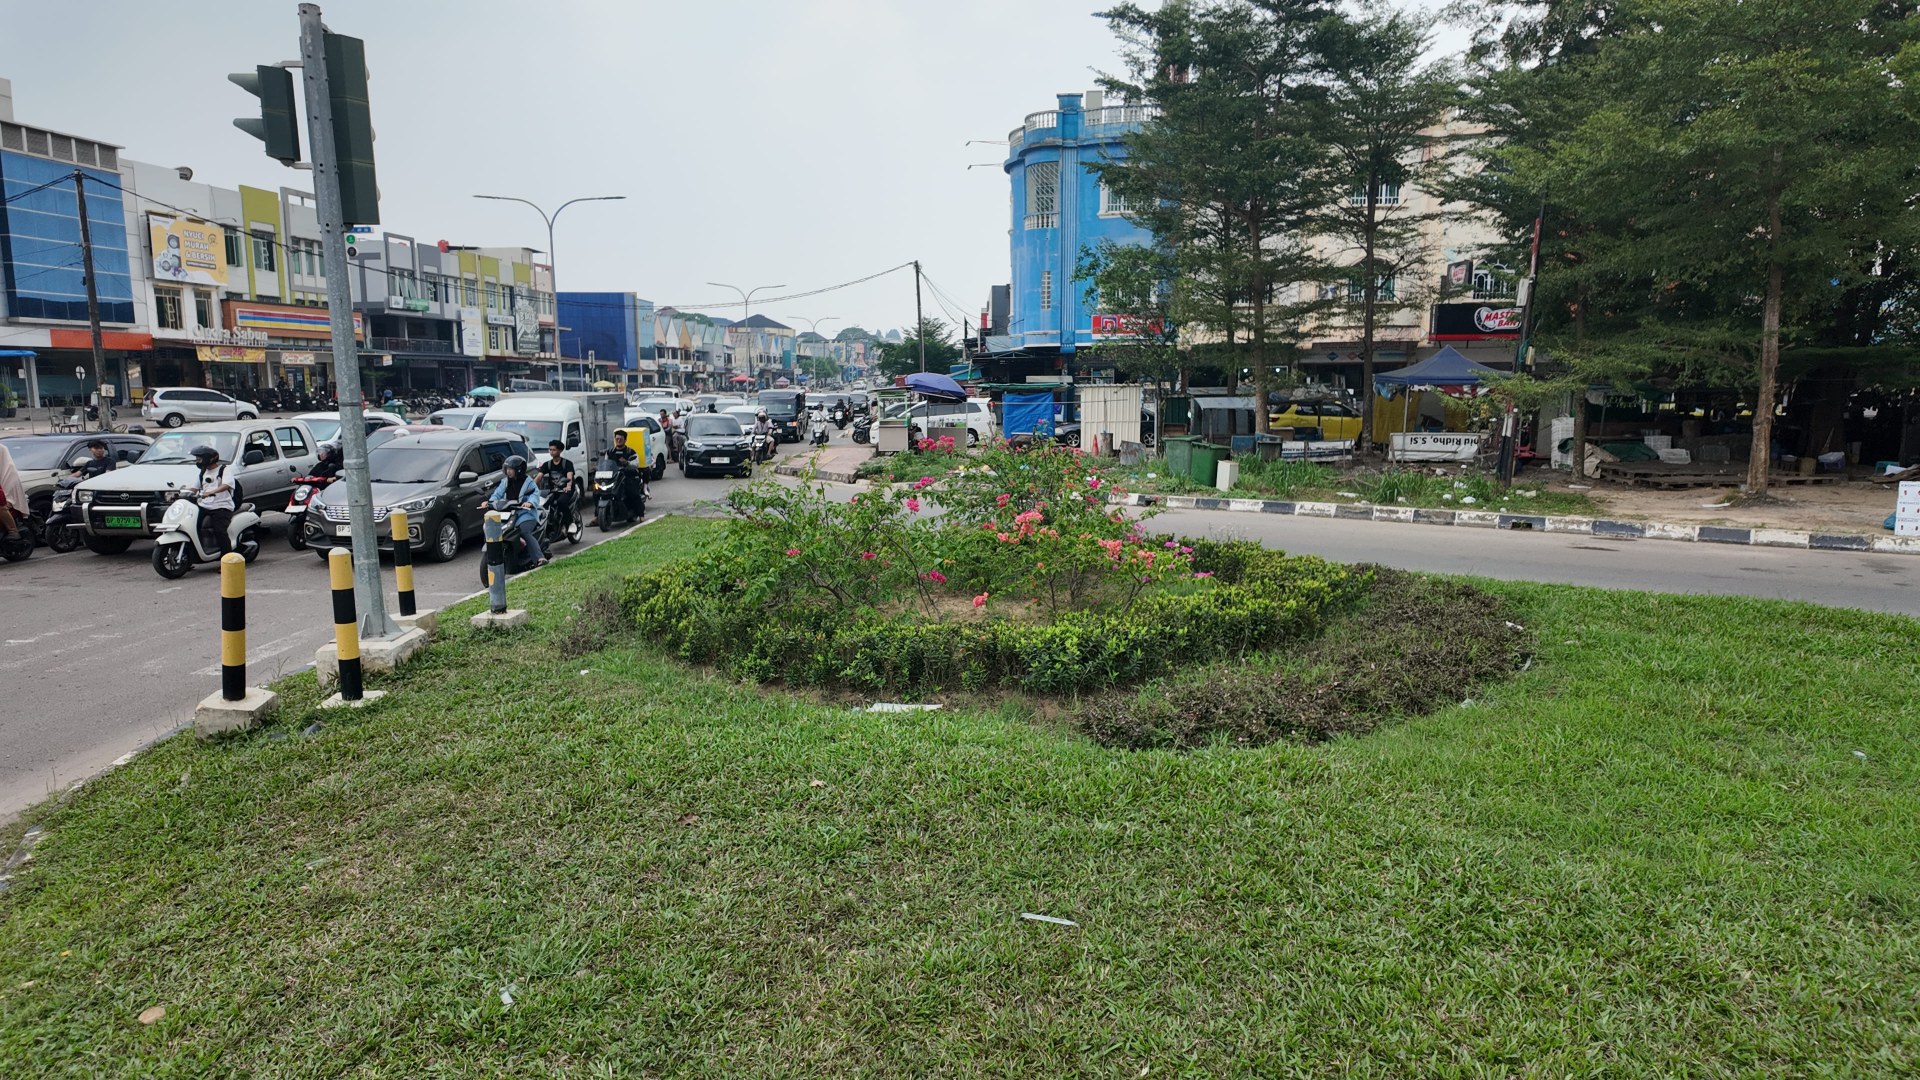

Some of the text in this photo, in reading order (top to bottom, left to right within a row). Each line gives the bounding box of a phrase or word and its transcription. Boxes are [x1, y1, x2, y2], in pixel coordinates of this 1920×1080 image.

[183, 230, 204, 240] NYUCI
[184, 240, 208, 250] MURAH
[192, 252, 216, 262] BERSIH
[1483, 310, 1520, 324] MAST
[233, 326, 268, 341] Sabun
[1410, 436, 1428, 445] S.Si
[1430, 436, 1462, 446] Ridho,
